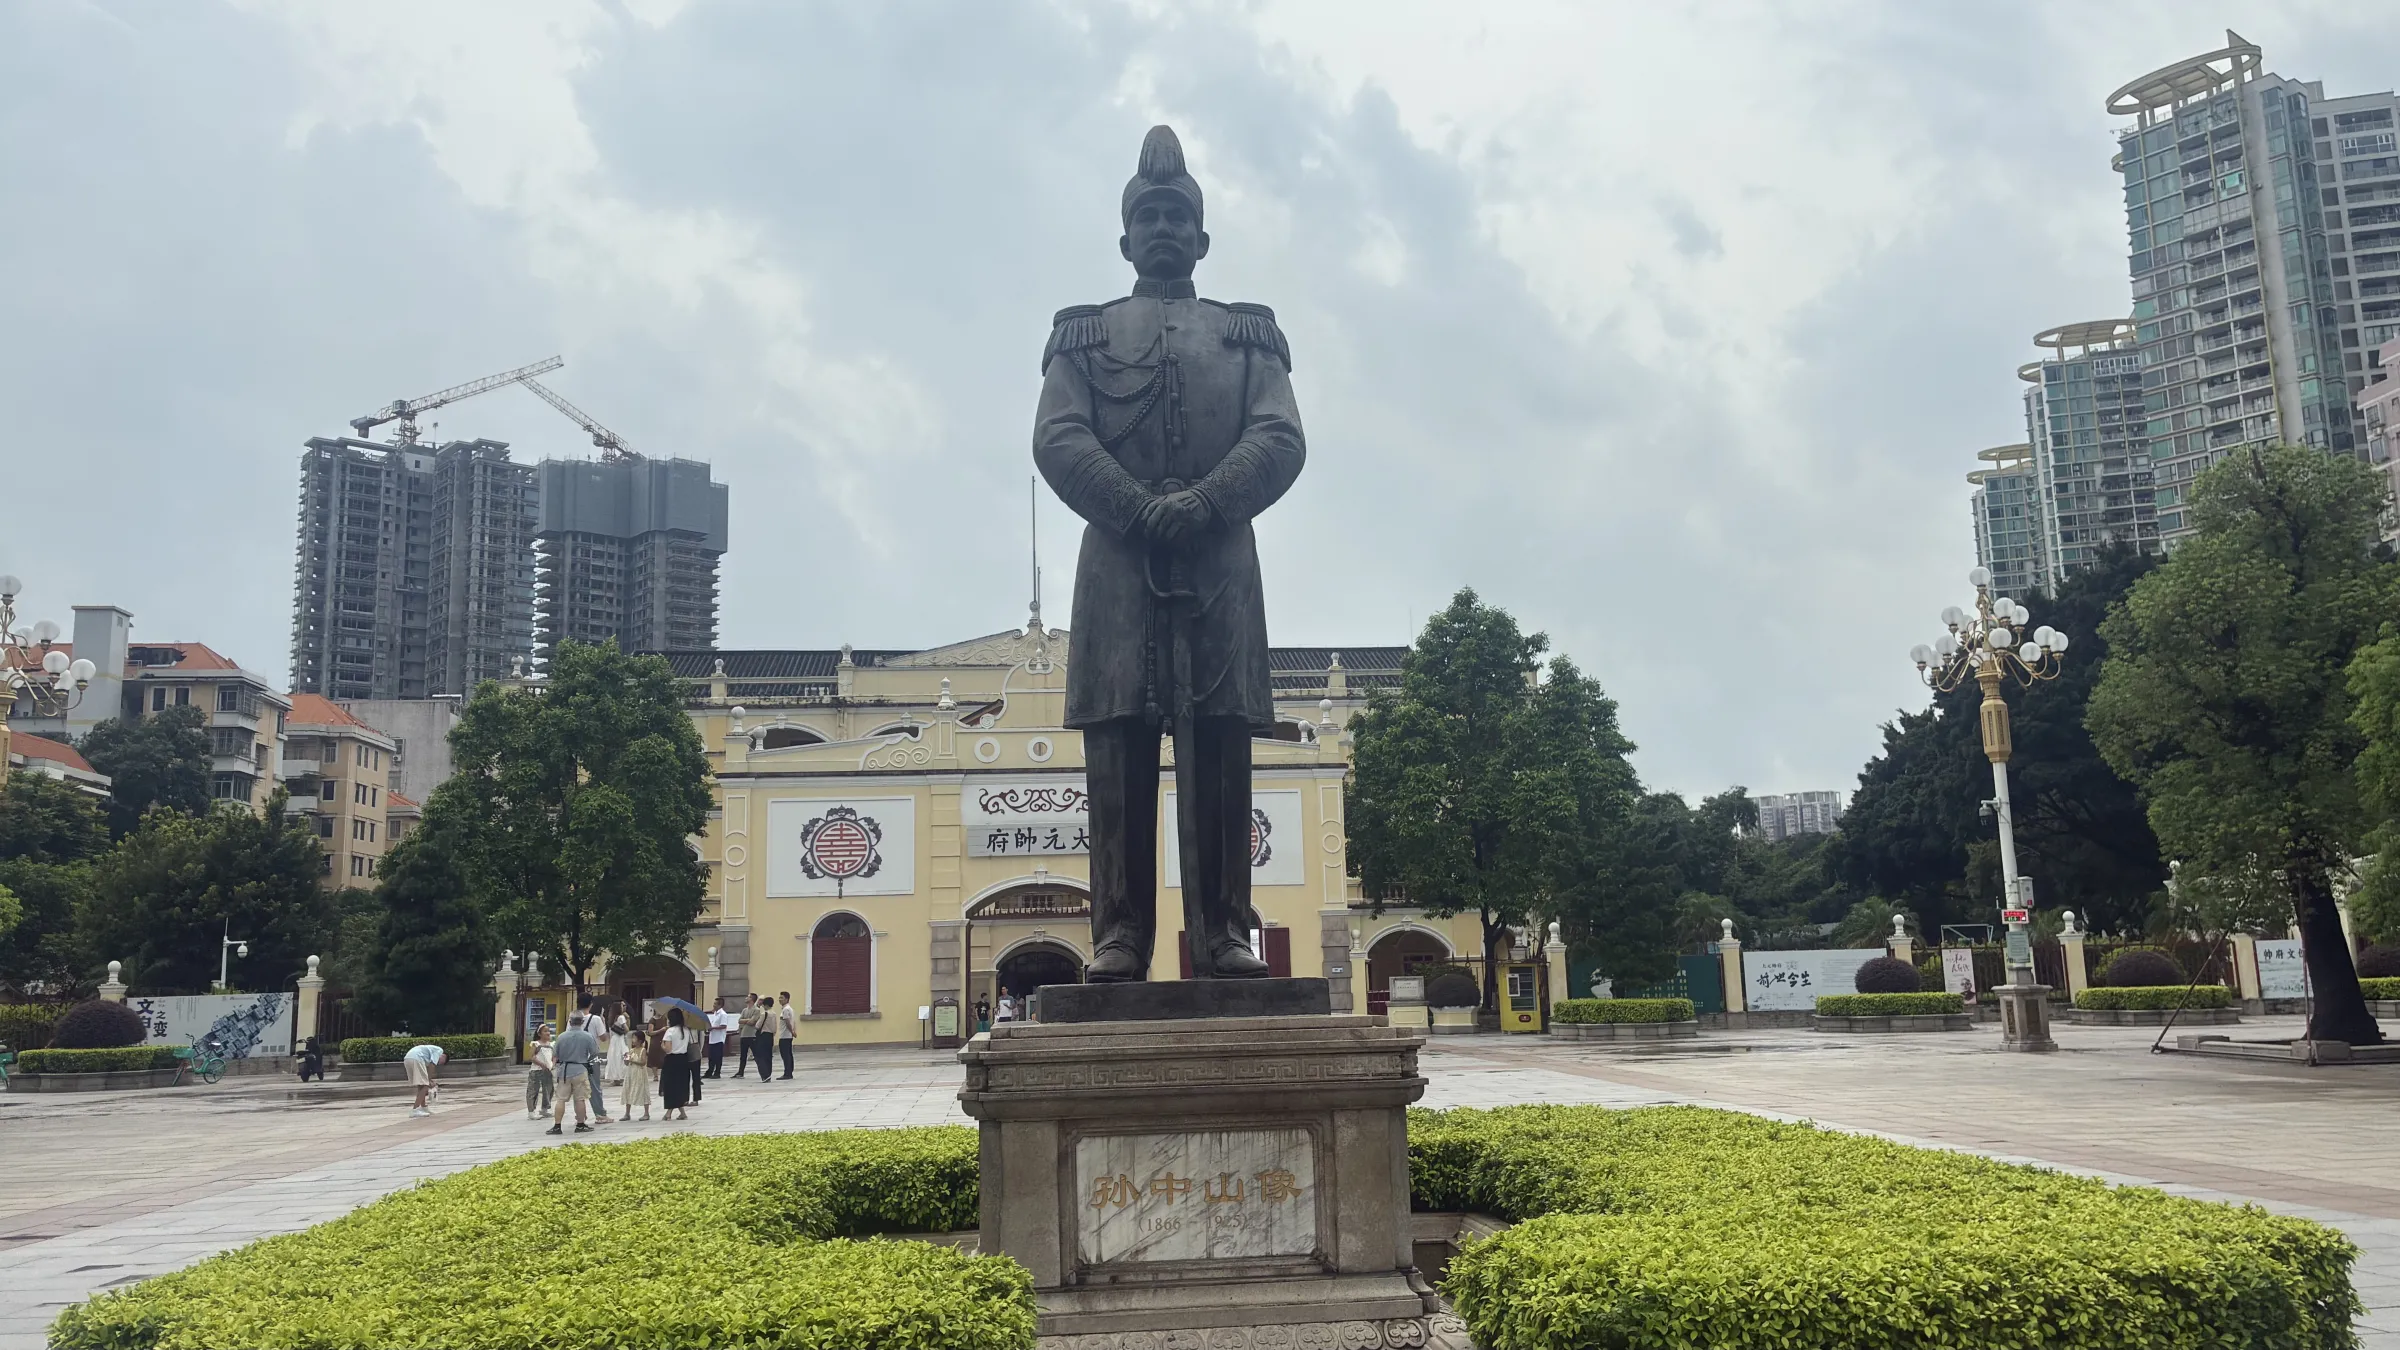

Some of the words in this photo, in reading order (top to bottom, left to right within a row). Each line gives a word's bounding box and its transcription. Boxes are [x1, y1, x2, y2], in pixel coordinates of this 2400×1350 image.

[1756, 970, 1812, 988] 前世今生
[153, 1010, 168, 1038] 之变
[1091, 1168, 1303, 1209] 孙中山像
[1138, 1216, 1181, 1233] (1866
